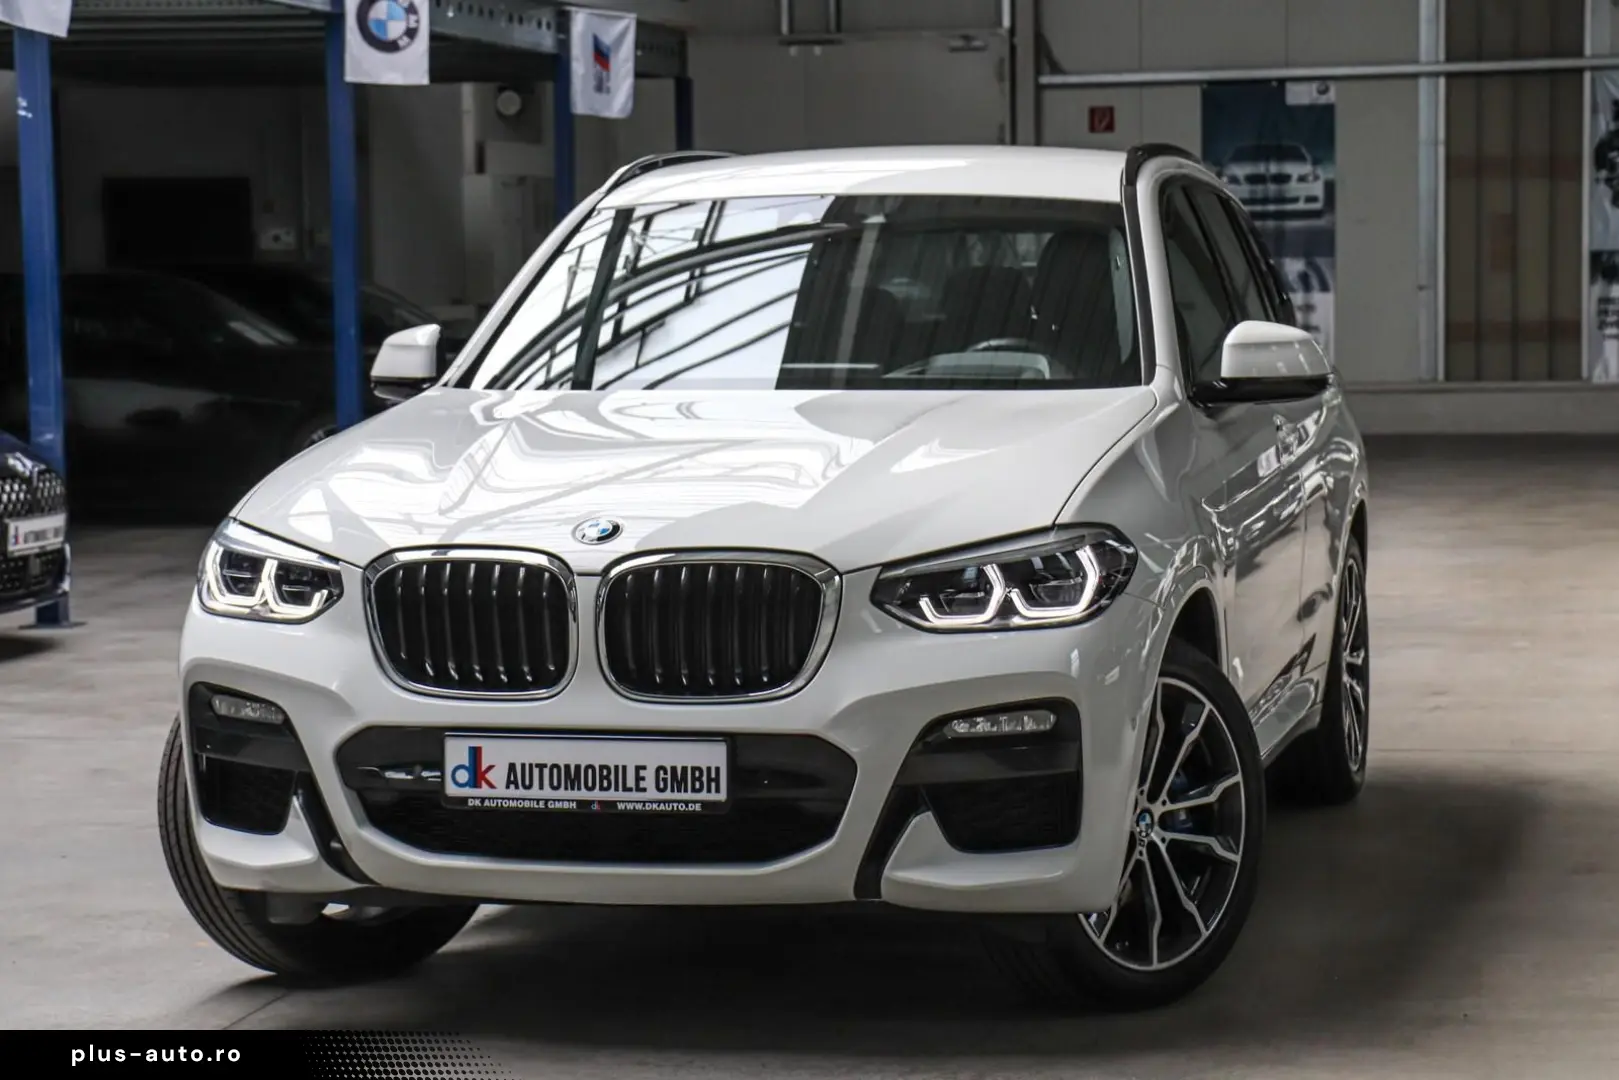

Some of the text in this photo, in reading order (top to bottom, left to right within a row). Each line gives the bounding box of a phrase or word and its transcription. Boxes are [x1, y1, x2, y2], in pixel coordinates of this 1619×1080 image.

[451, 746, 721, 794] dk AUTOMOBILE GMBH
[467, 798, 481, 807] DK
[484, 799, 545, 808] AUTOMOBILE
[548, 800, 577, 809] GMBH
[617, 802, 702, 811] WWW.DKAUTO.DE
